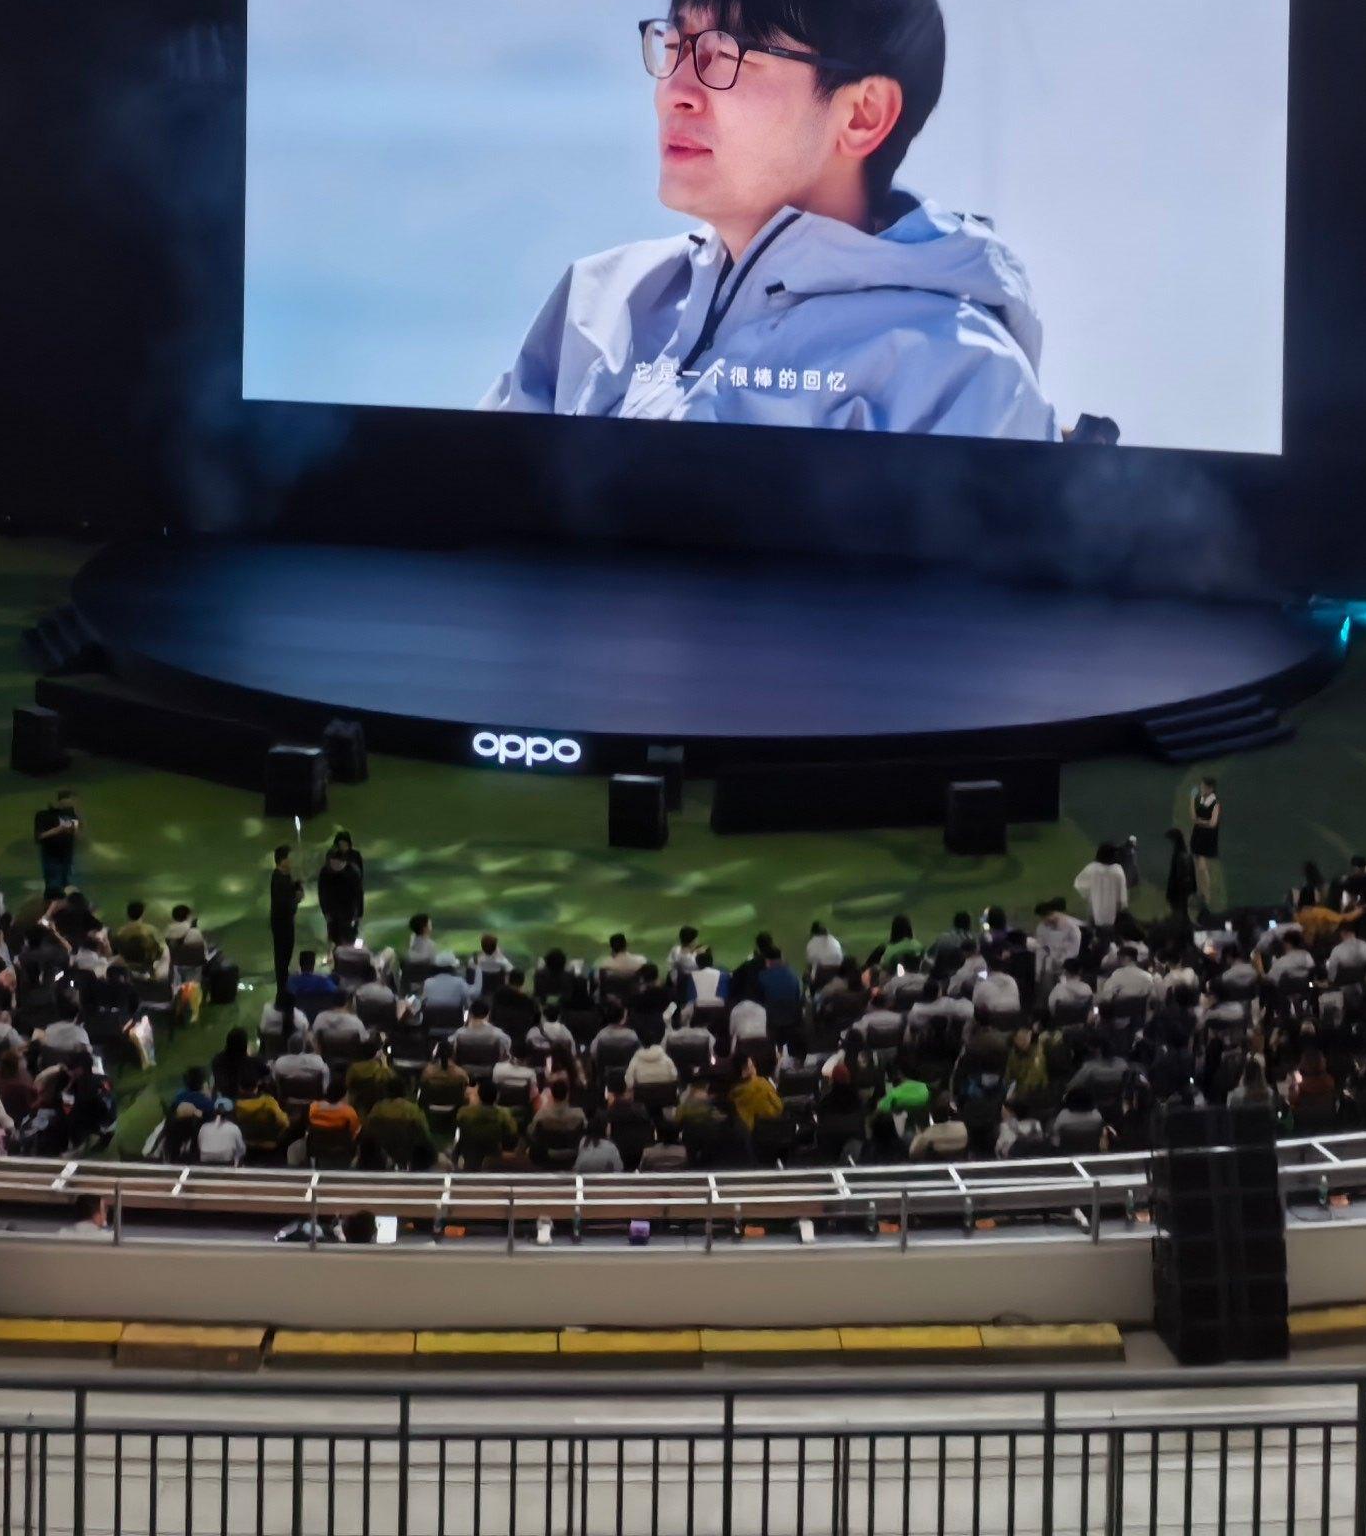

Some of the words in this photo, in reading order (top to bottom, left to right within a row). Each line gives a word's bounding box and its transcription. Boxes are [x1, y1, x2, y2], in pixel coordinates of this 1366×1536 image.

[635, 360, 847, 393] 它是一个很棒的回忆
[472, 732, 581, 767] oppo
